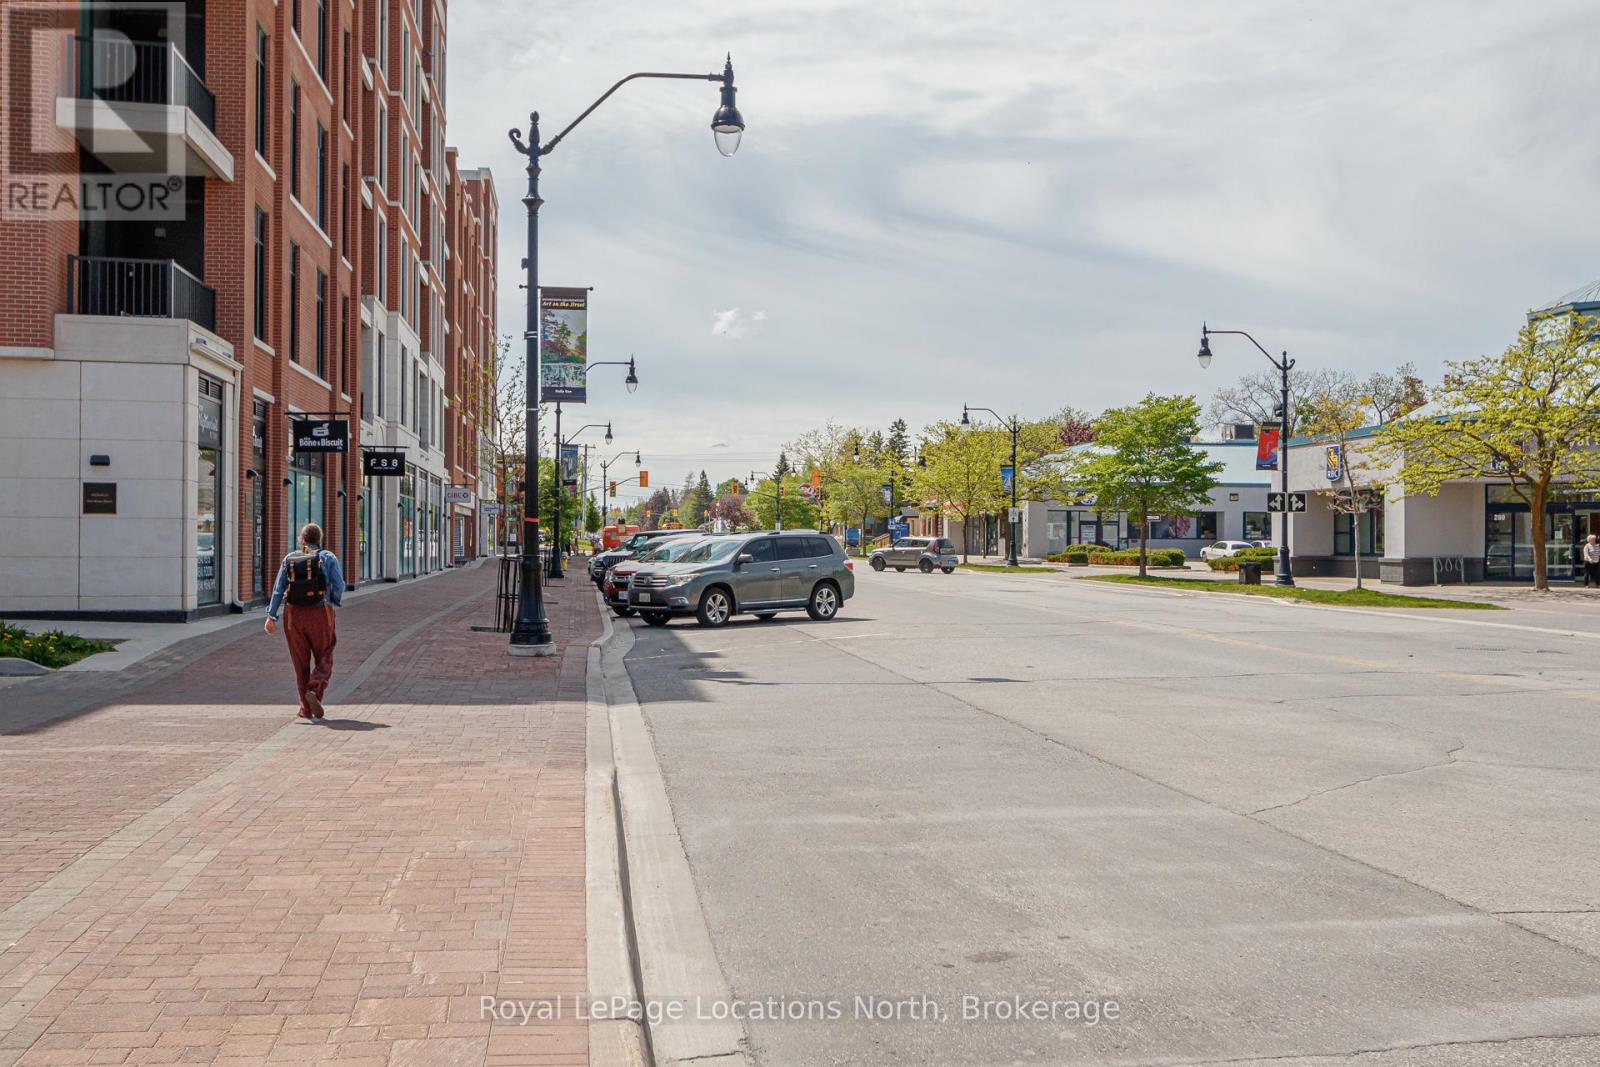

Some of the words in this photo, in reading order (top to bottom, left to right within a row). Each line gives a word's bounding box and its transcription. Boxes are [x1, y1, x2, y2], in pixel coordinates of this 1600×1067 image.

[299, 438, 317, 447] Bone
[320, 438, 343, 447] Biscuit
[1327, 470, 1339, 478] RBC
